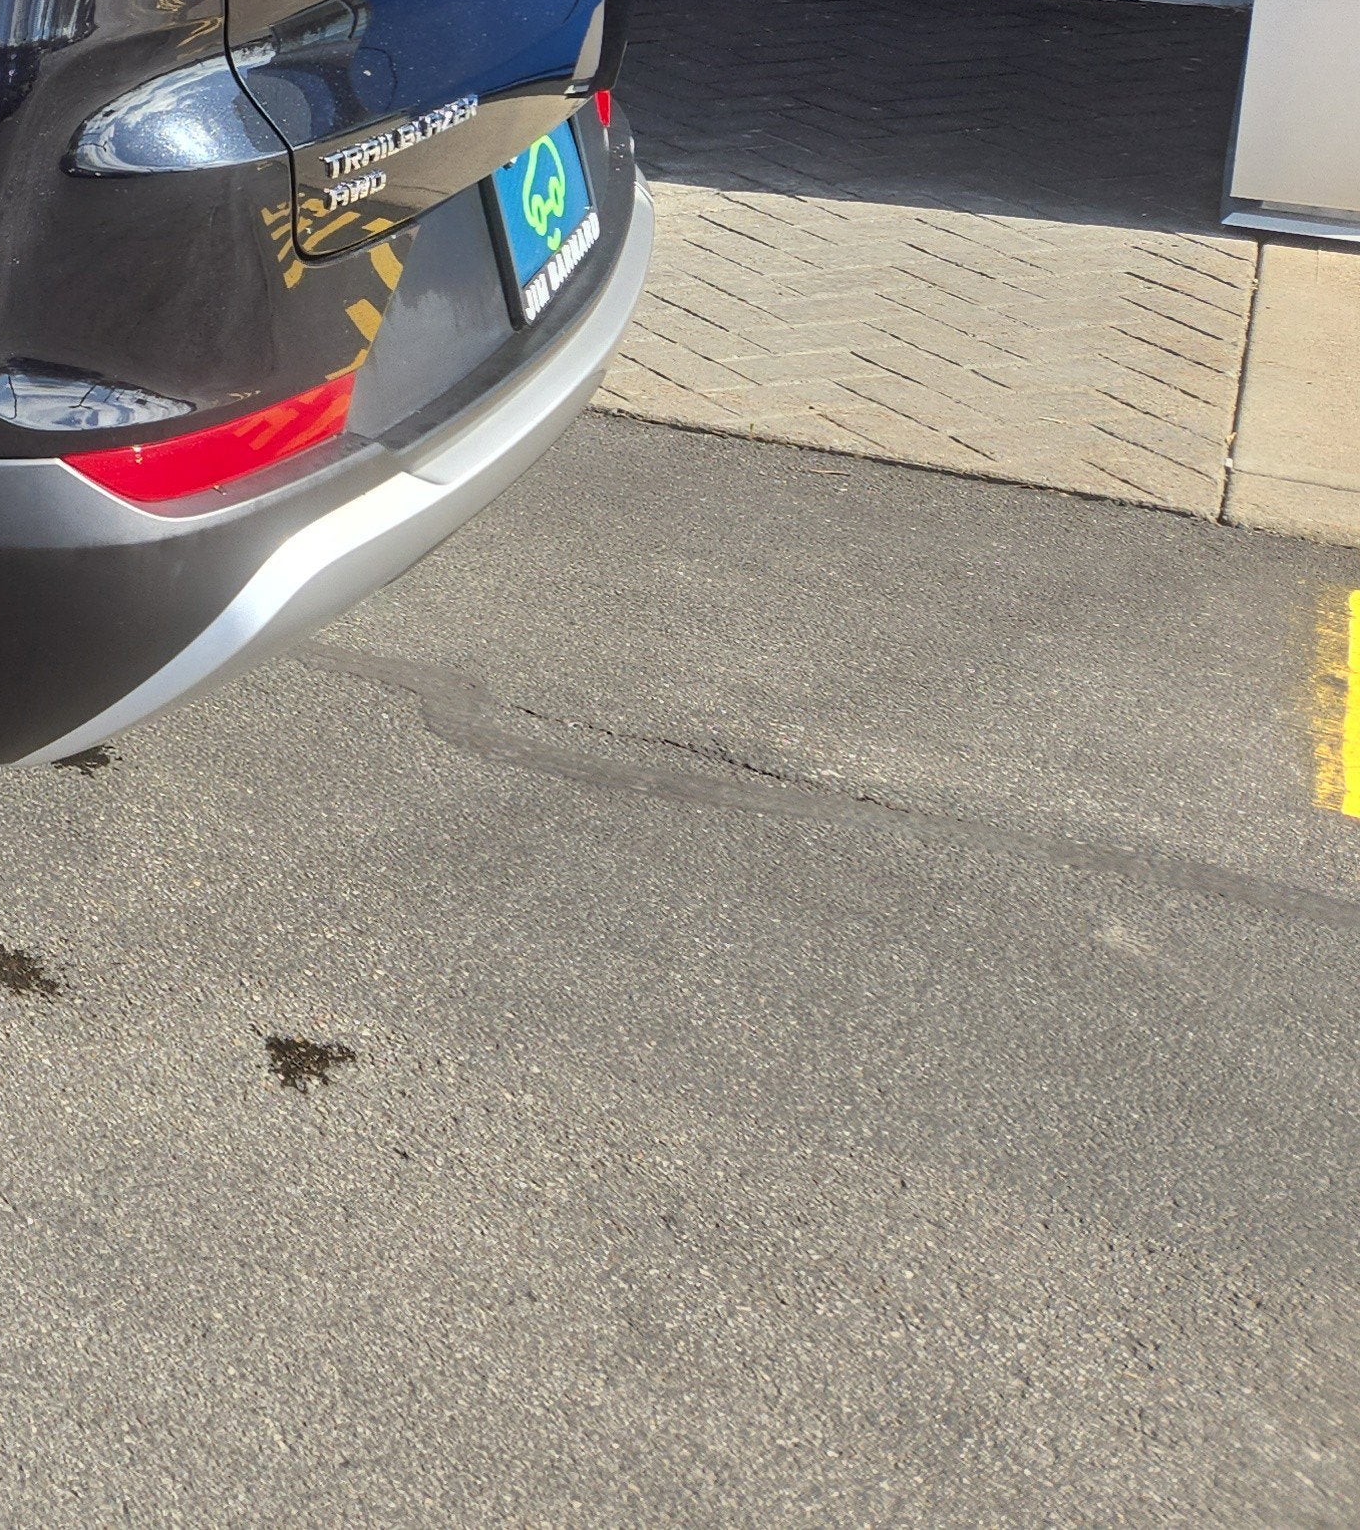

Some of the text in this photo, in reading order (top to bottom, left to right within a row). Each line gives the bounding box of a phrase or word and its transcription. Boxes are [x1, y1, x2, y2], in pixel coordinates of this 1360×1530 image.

[319, 94, 479, 179] TRAILBLAZER
[325, 170, 387, 211] AWD
[524, 212, 600, 321] JIM BARNARD
